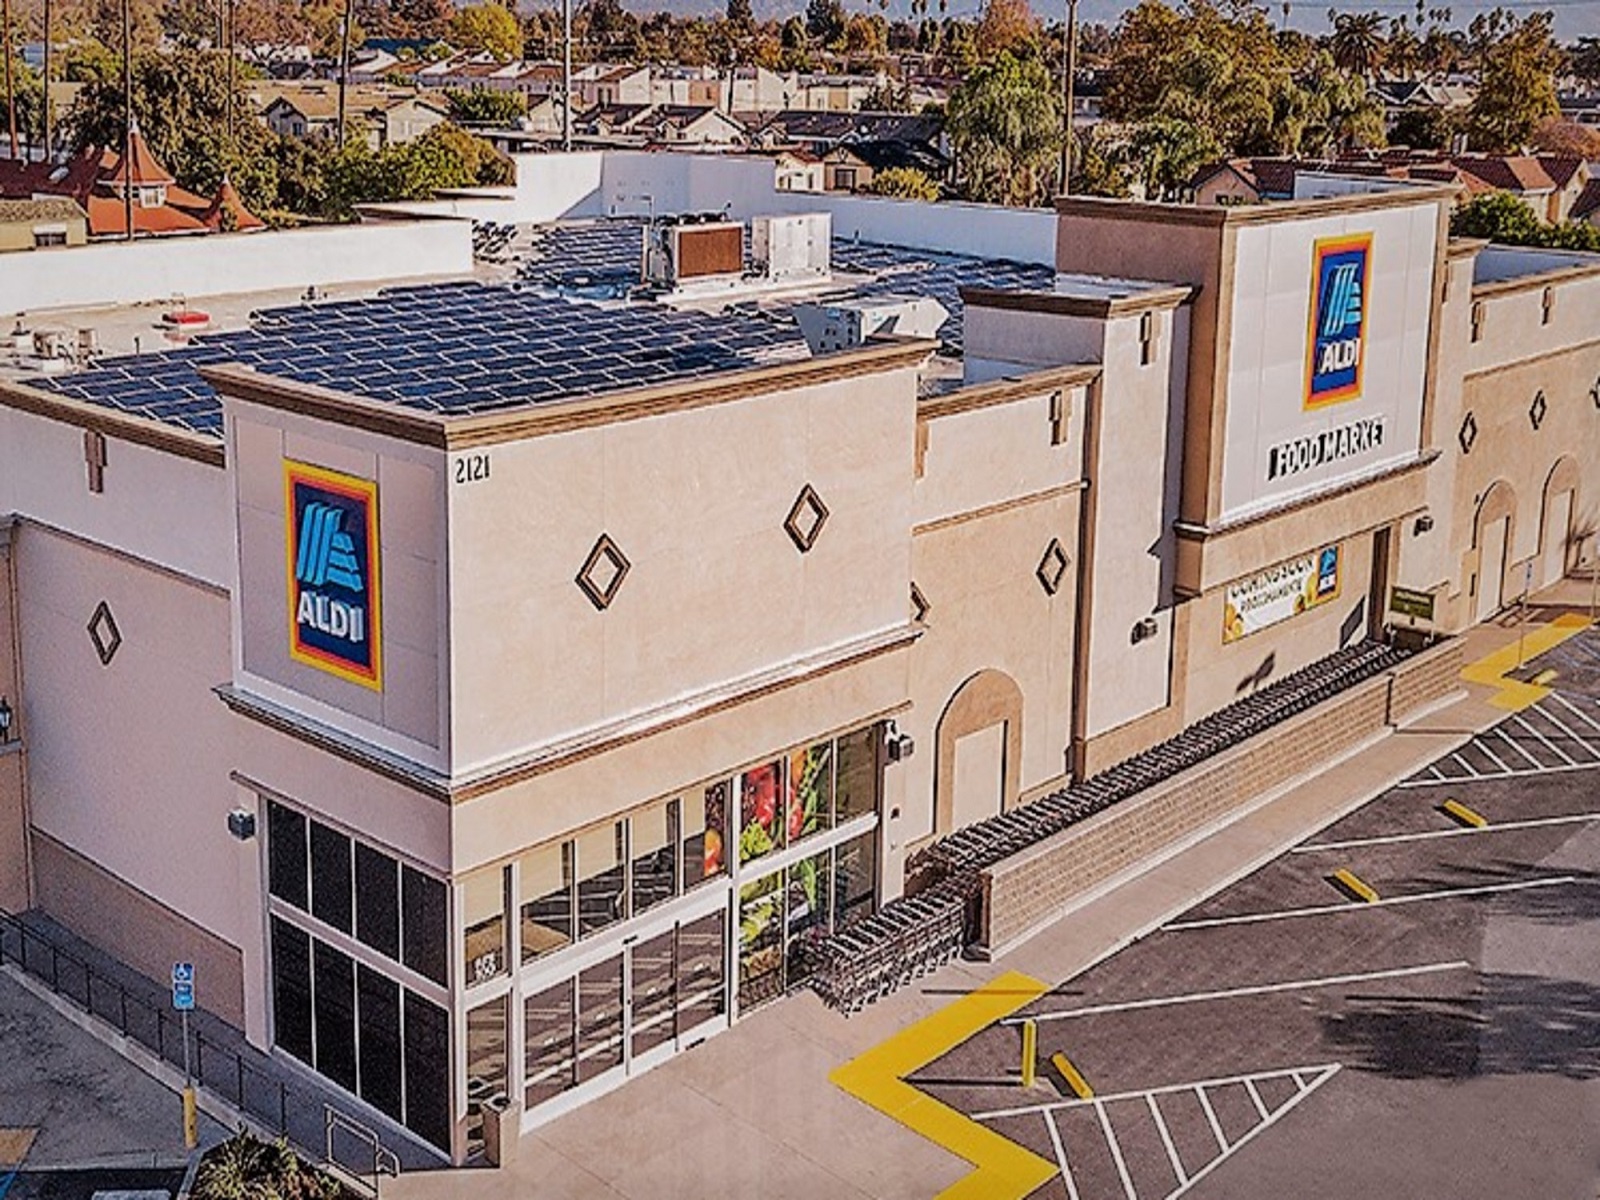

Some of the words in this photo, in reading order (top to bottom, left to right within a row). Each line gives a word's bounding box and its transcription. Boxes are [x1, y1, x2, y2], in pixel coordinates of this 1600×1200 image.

[1319, 337, 1361, 375] ALDI
[455, 455, 490, 483] 2121
[1267, 437, 1321, 481] FOOD
[297, 590, 365, 643] ALDI
